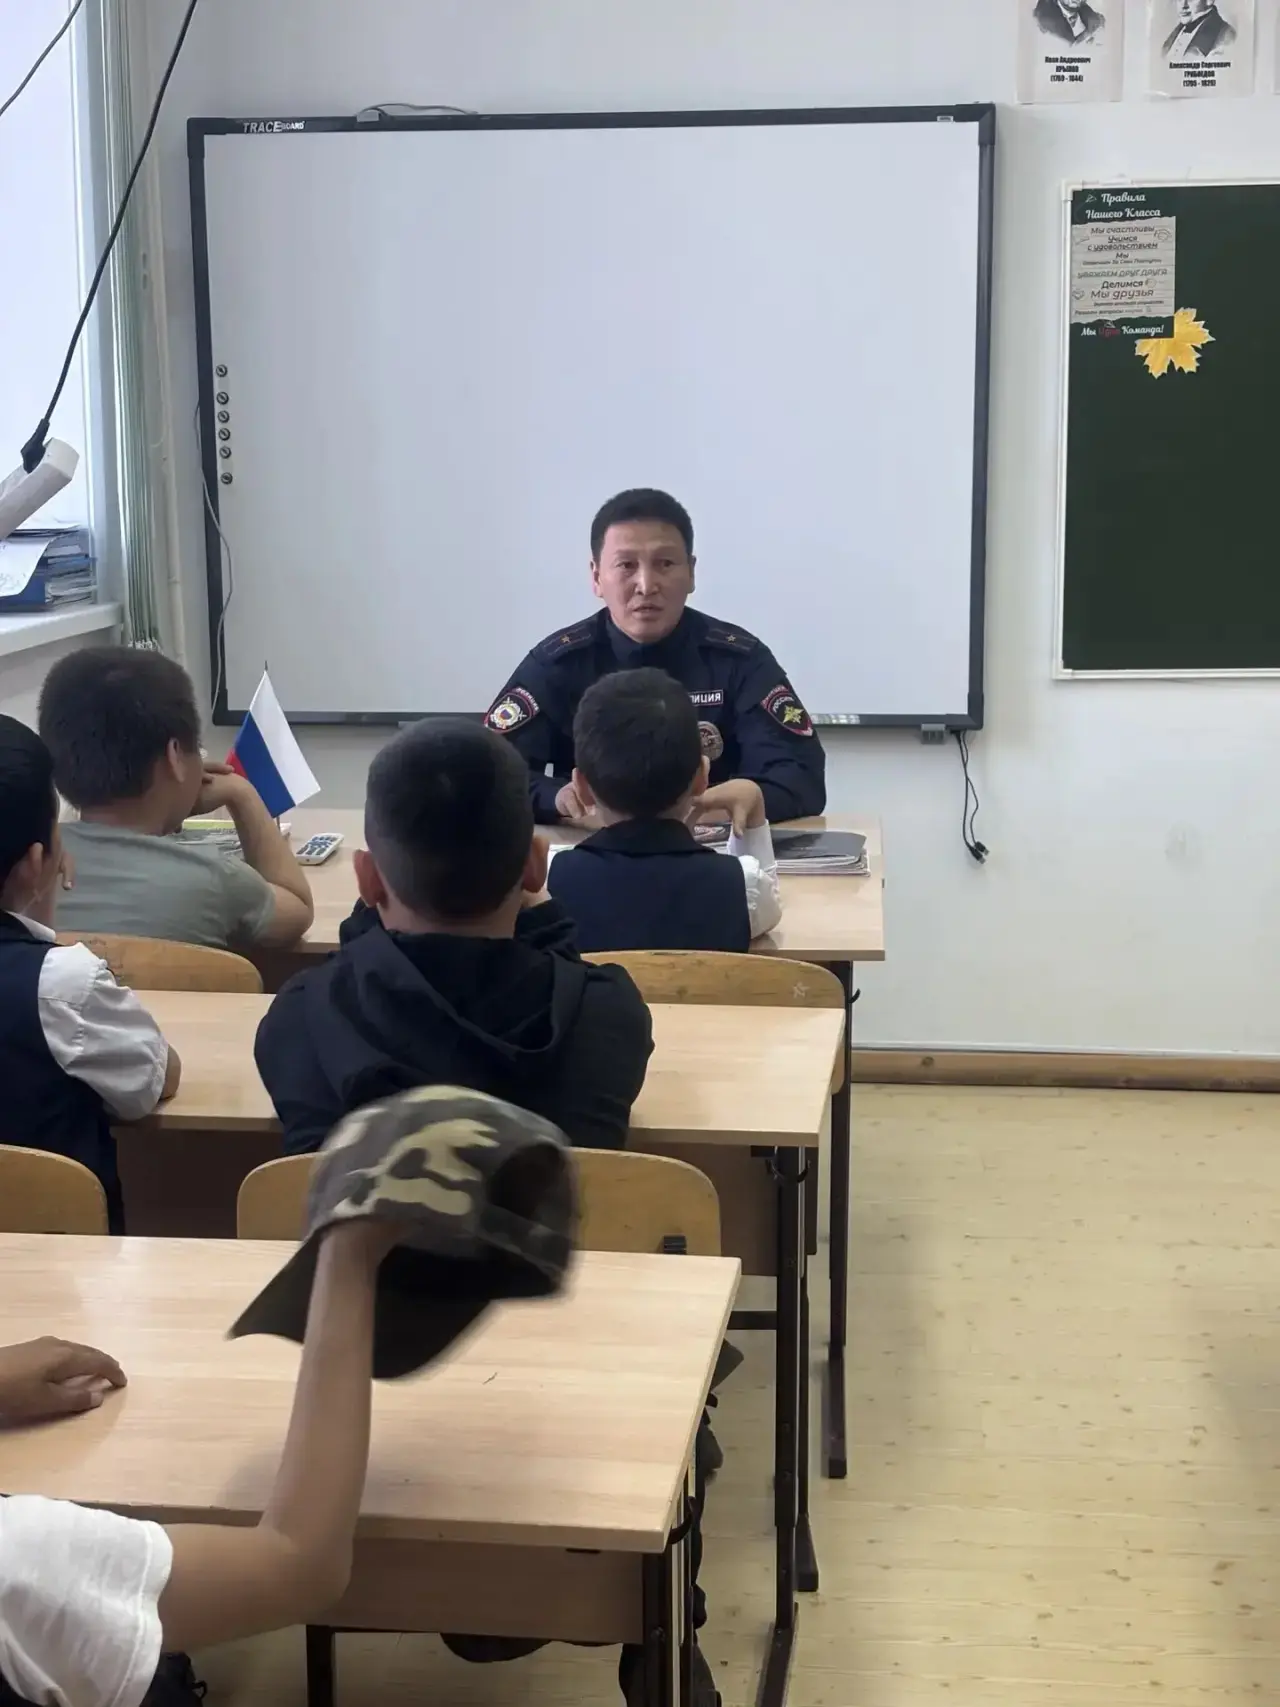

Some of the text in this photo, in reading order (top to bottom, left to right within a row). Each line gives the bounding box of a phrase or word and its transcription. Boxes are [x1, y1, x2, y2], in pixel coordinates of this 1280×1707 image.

[1169, 61, 1200, 69] Александр
[1101, 191, 1146, 206] Правила
[1085, 207, 1161, 219] Нашего Класса
[1101, 280, 1143, 290] Делимся
[1090, 289, 1154, 300] Мы друзья
[1081, 327, 1096, 336] Мы
[1121, 324, 1164, 337] Команда!
